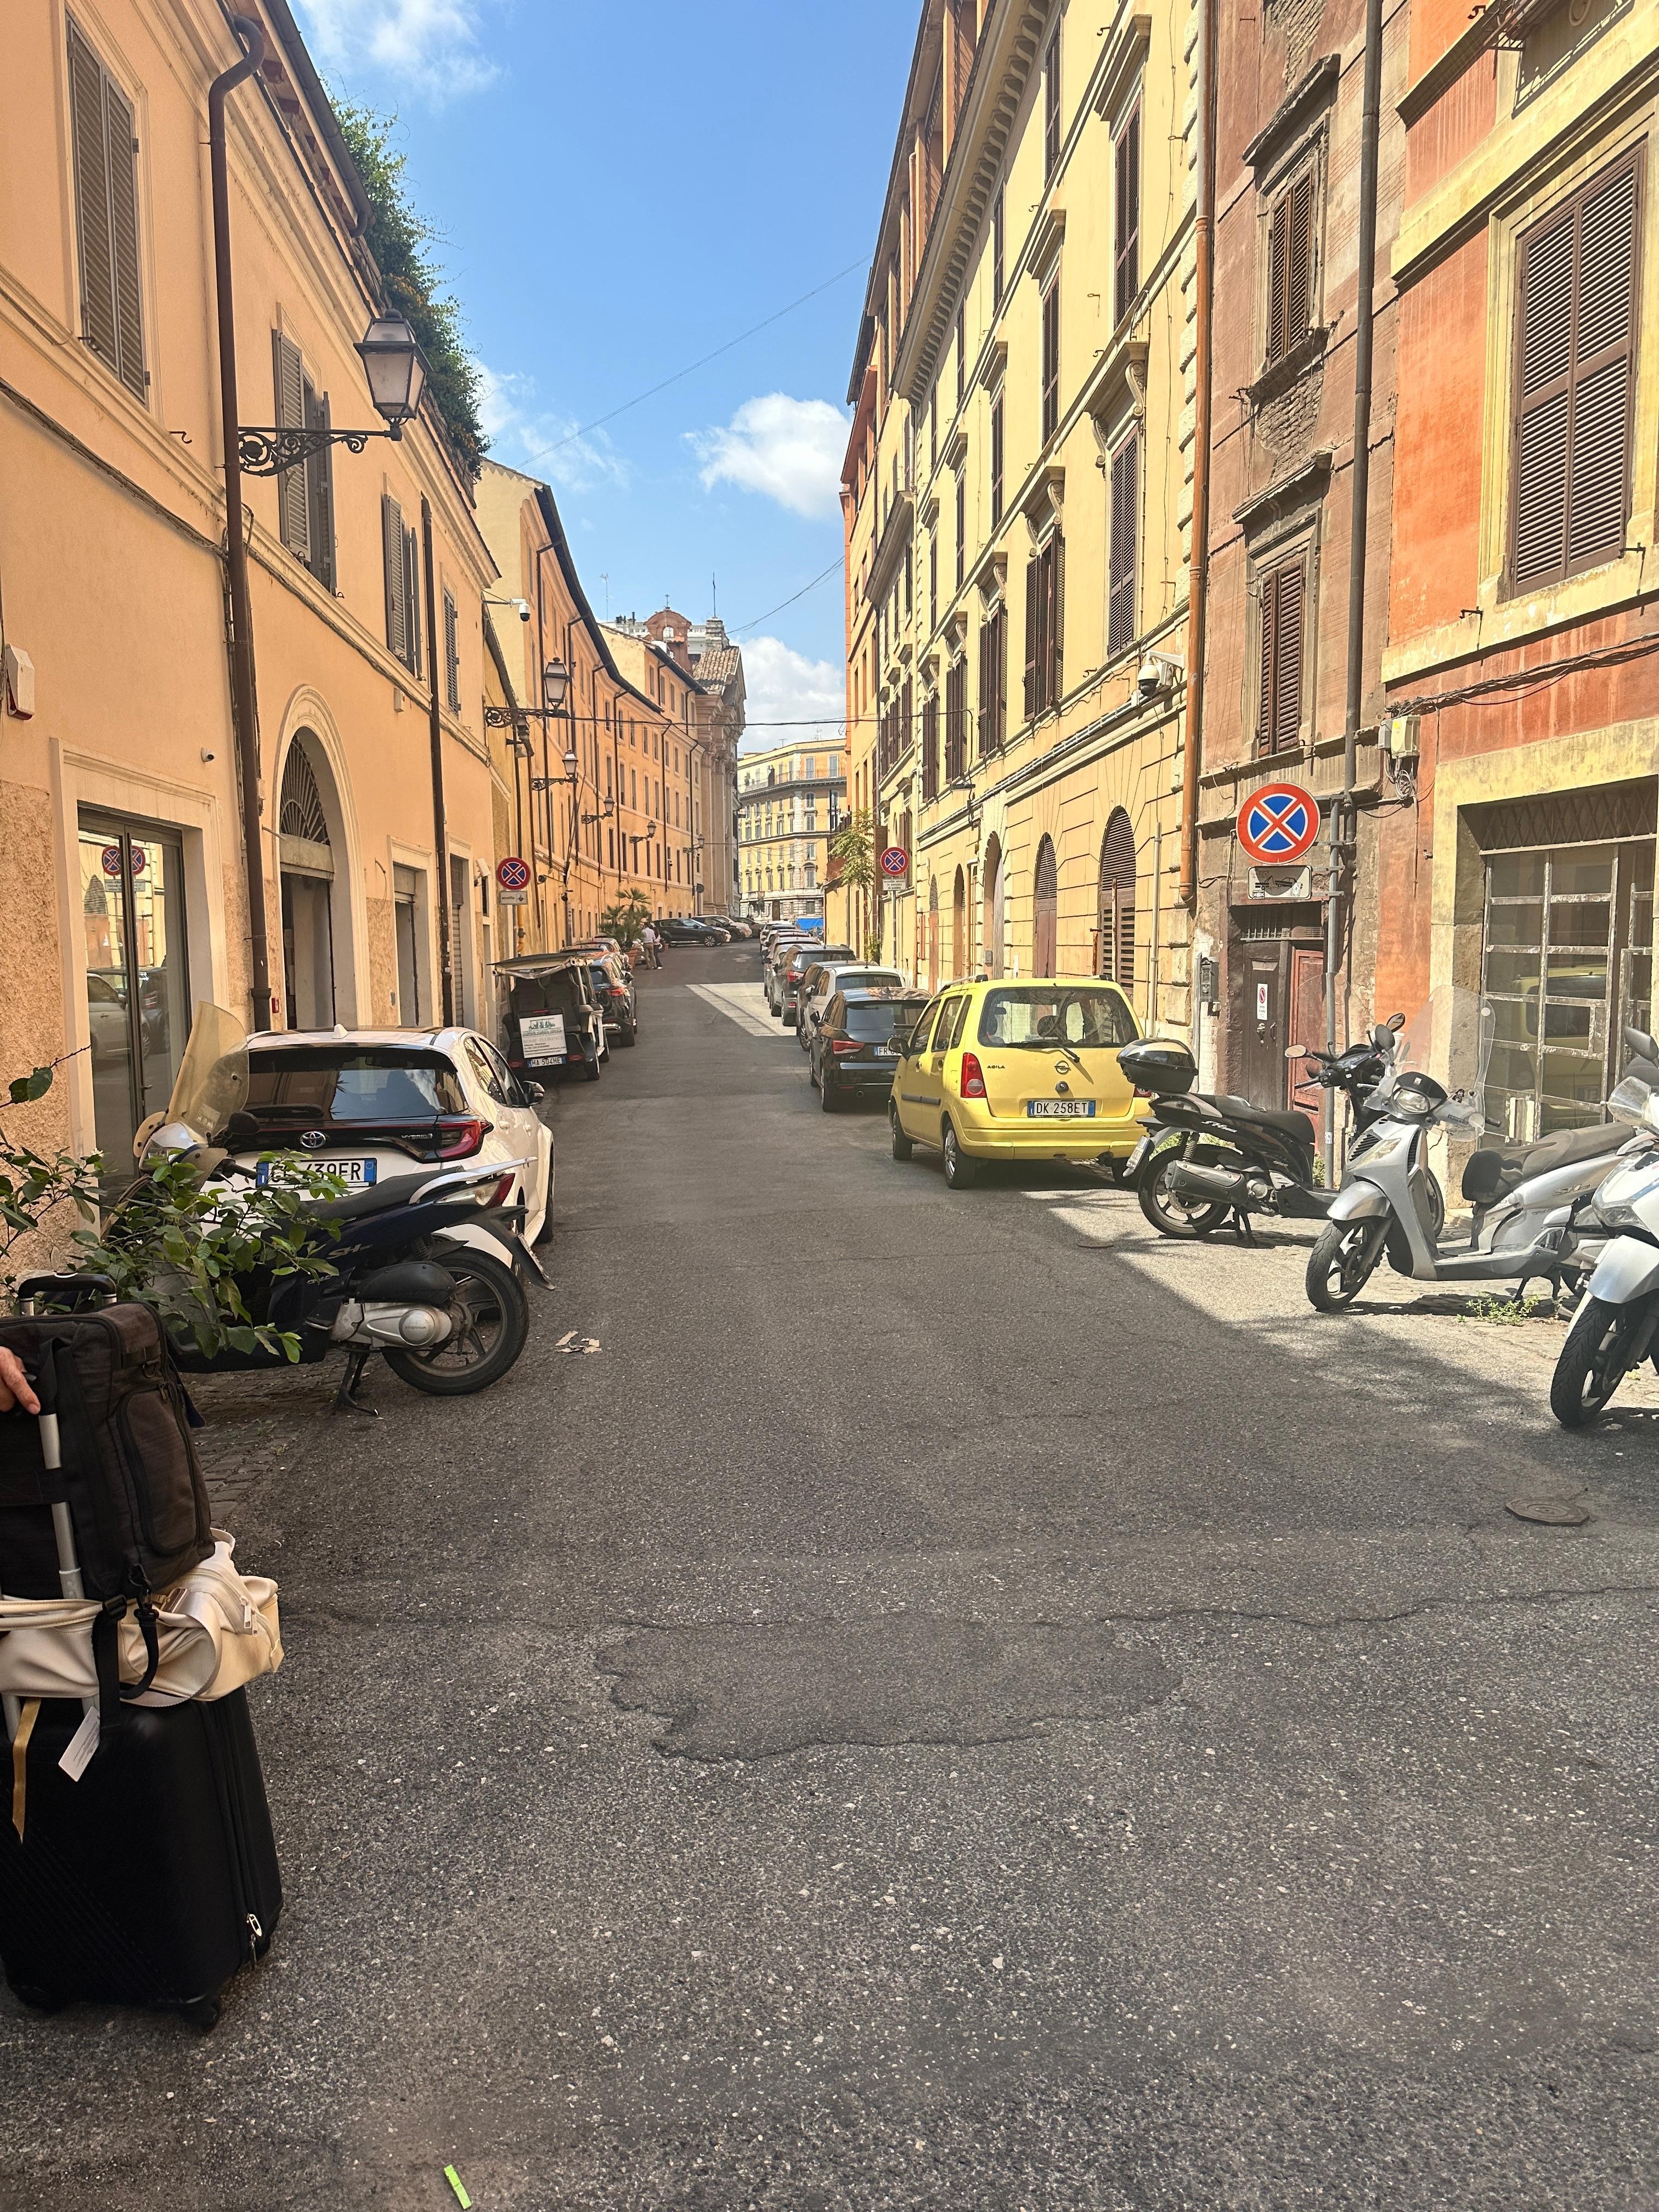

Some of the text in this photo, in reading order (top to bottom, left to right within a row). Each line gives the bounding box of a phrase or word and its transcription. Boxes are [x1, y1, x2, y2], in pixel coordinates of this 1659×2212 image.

[541, 1057, 561, 1065] 504HE
[1036, 1103, 1049, 1114] DK
[1053, 1102, 1087, 1114] 258ET
